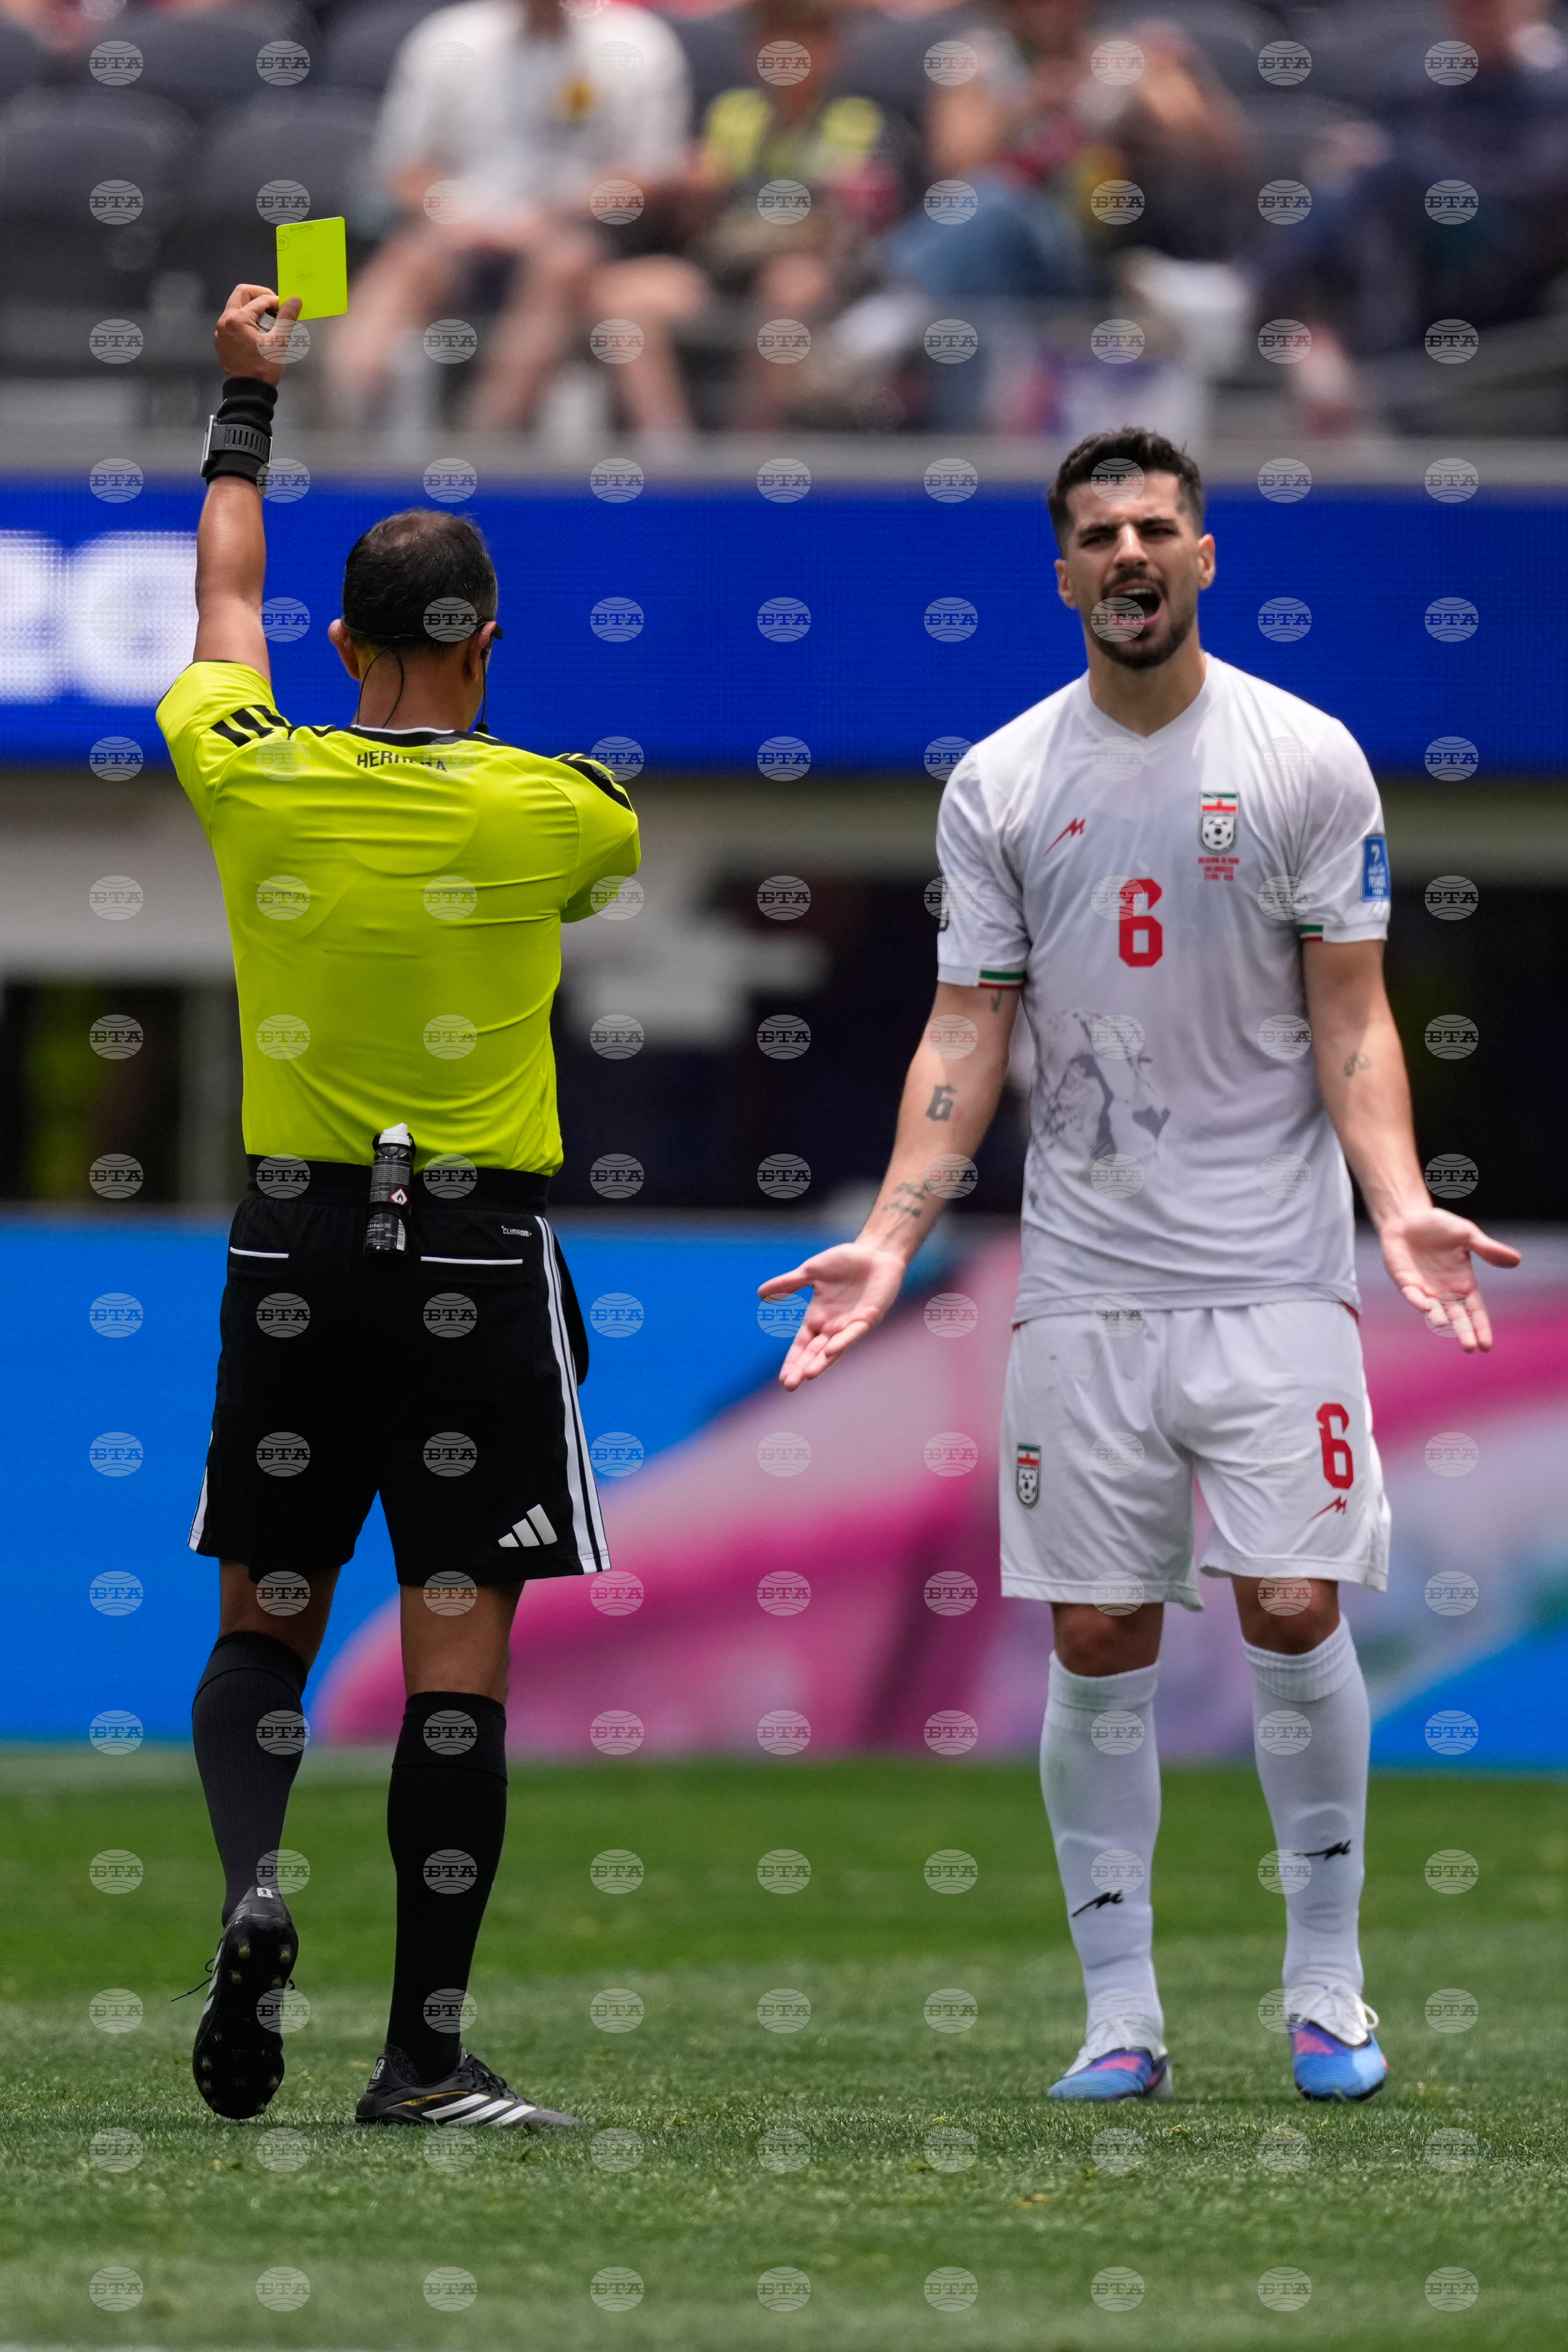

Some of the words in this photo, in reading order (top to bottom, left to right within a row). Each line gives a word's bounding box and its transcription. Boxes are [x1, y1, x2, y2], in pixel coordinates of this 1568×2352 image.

[357, 751, 448, 772] HERRA
[1120, 878, 1163, 968] 6
[1316, 1403, 1353, 1490] 6
